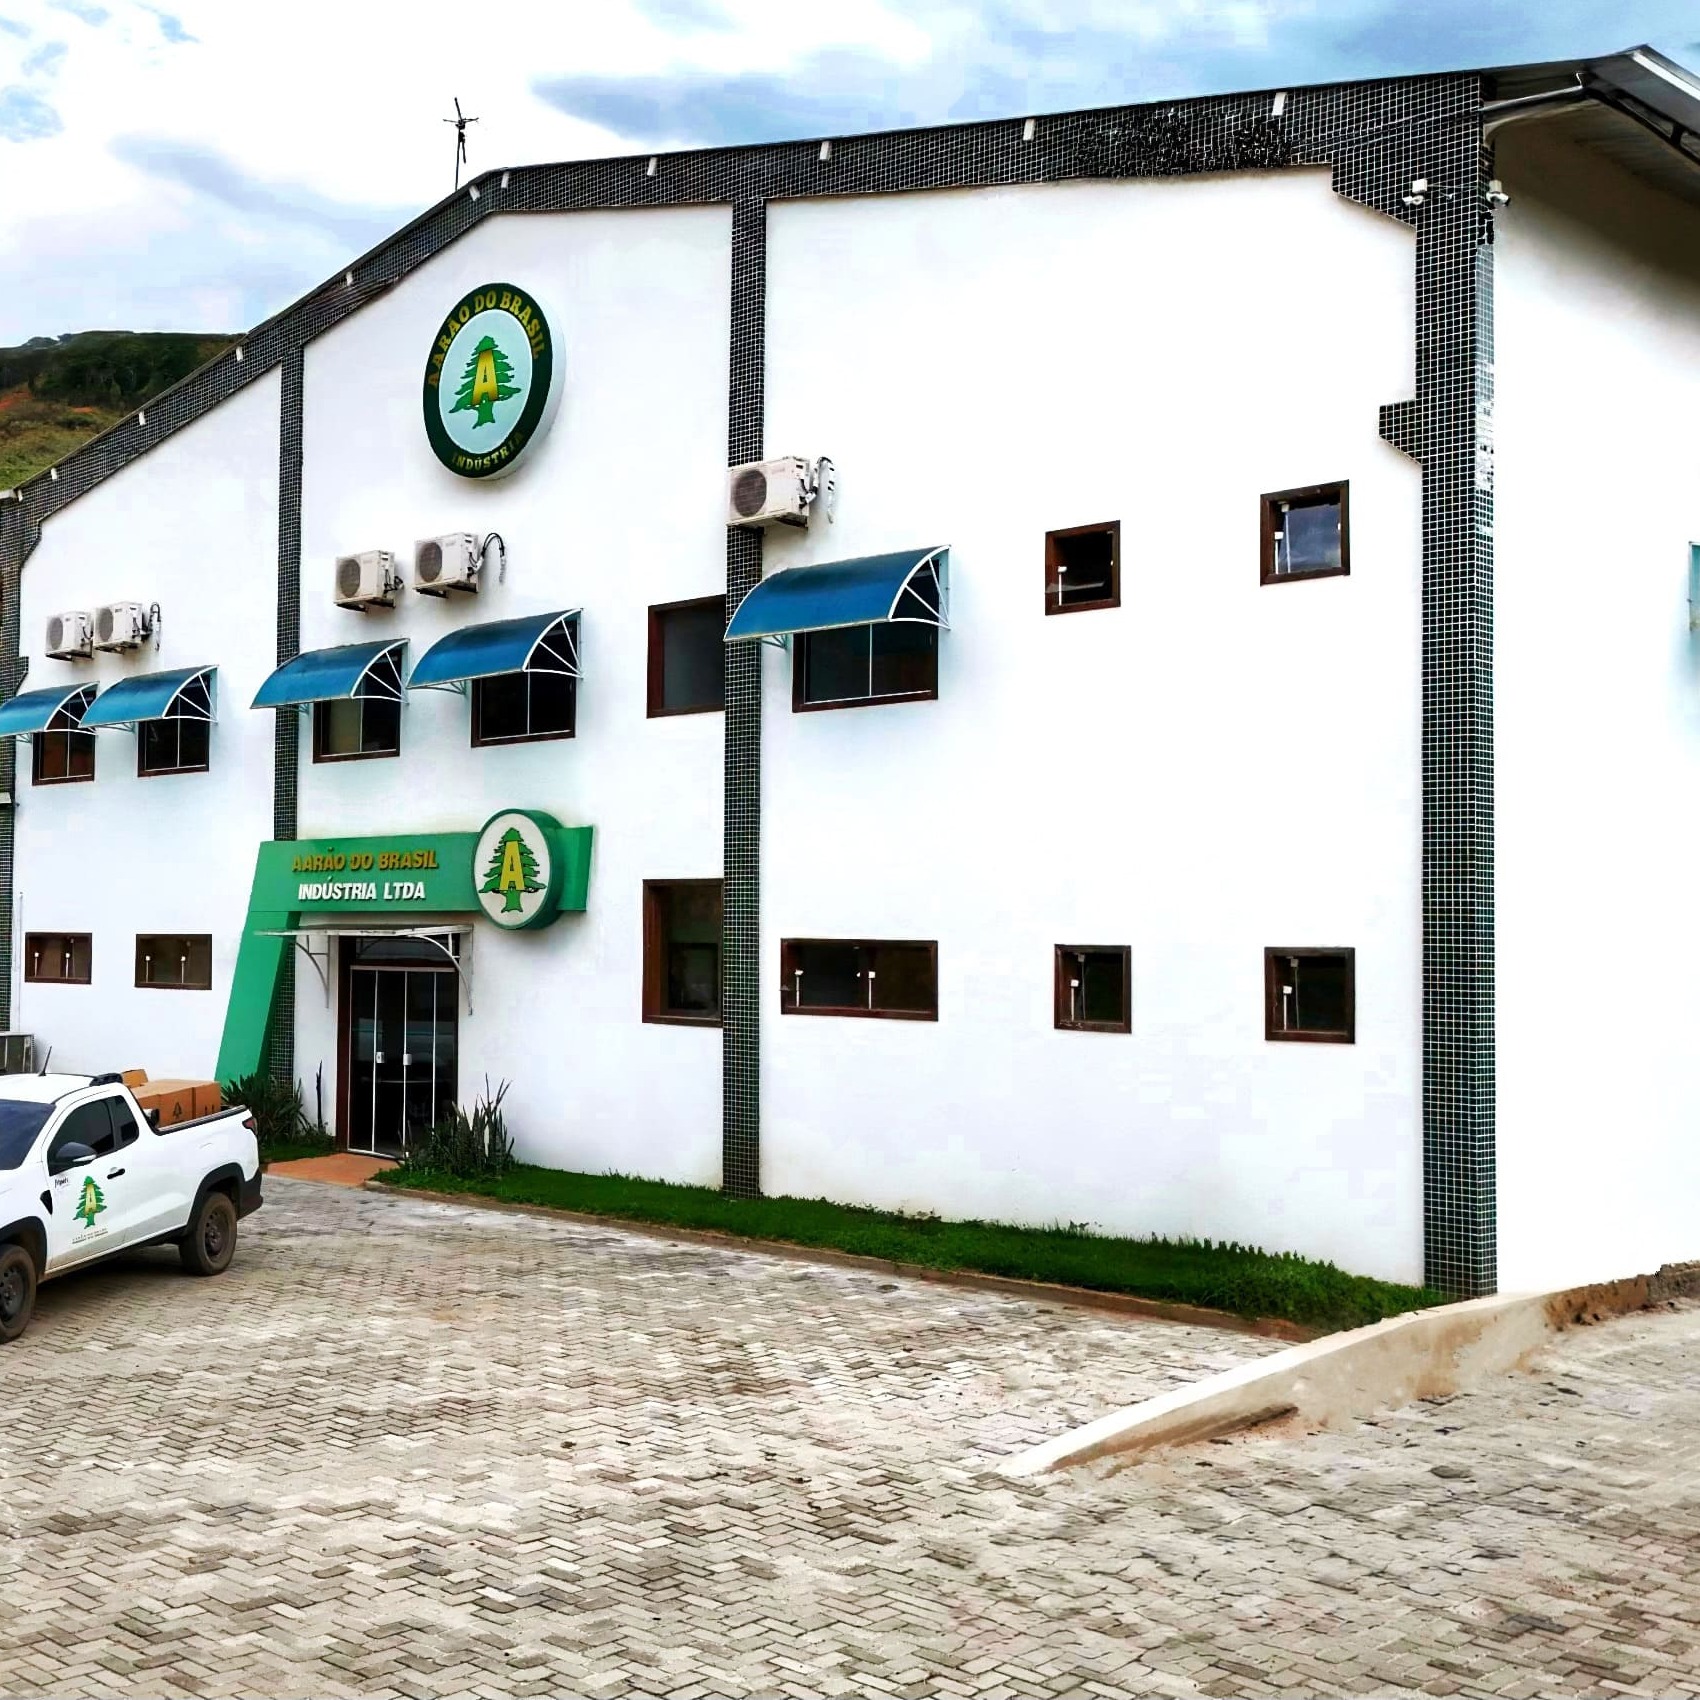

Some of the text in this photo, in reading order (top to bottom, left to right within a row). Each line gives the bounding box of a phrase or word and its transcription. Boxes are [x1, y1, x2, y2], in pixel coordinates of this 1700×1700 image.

[474, 290, 497, 314] DO
[500, 291, 545, 360] BRASIL
[472, 350, 499, 405] A
[291, 846, 438, 872] AARÃO DO BRASIL
[500, 840, 525, 891] A
[298, 876, 426, 901] INDÚSTRIA LTDA
